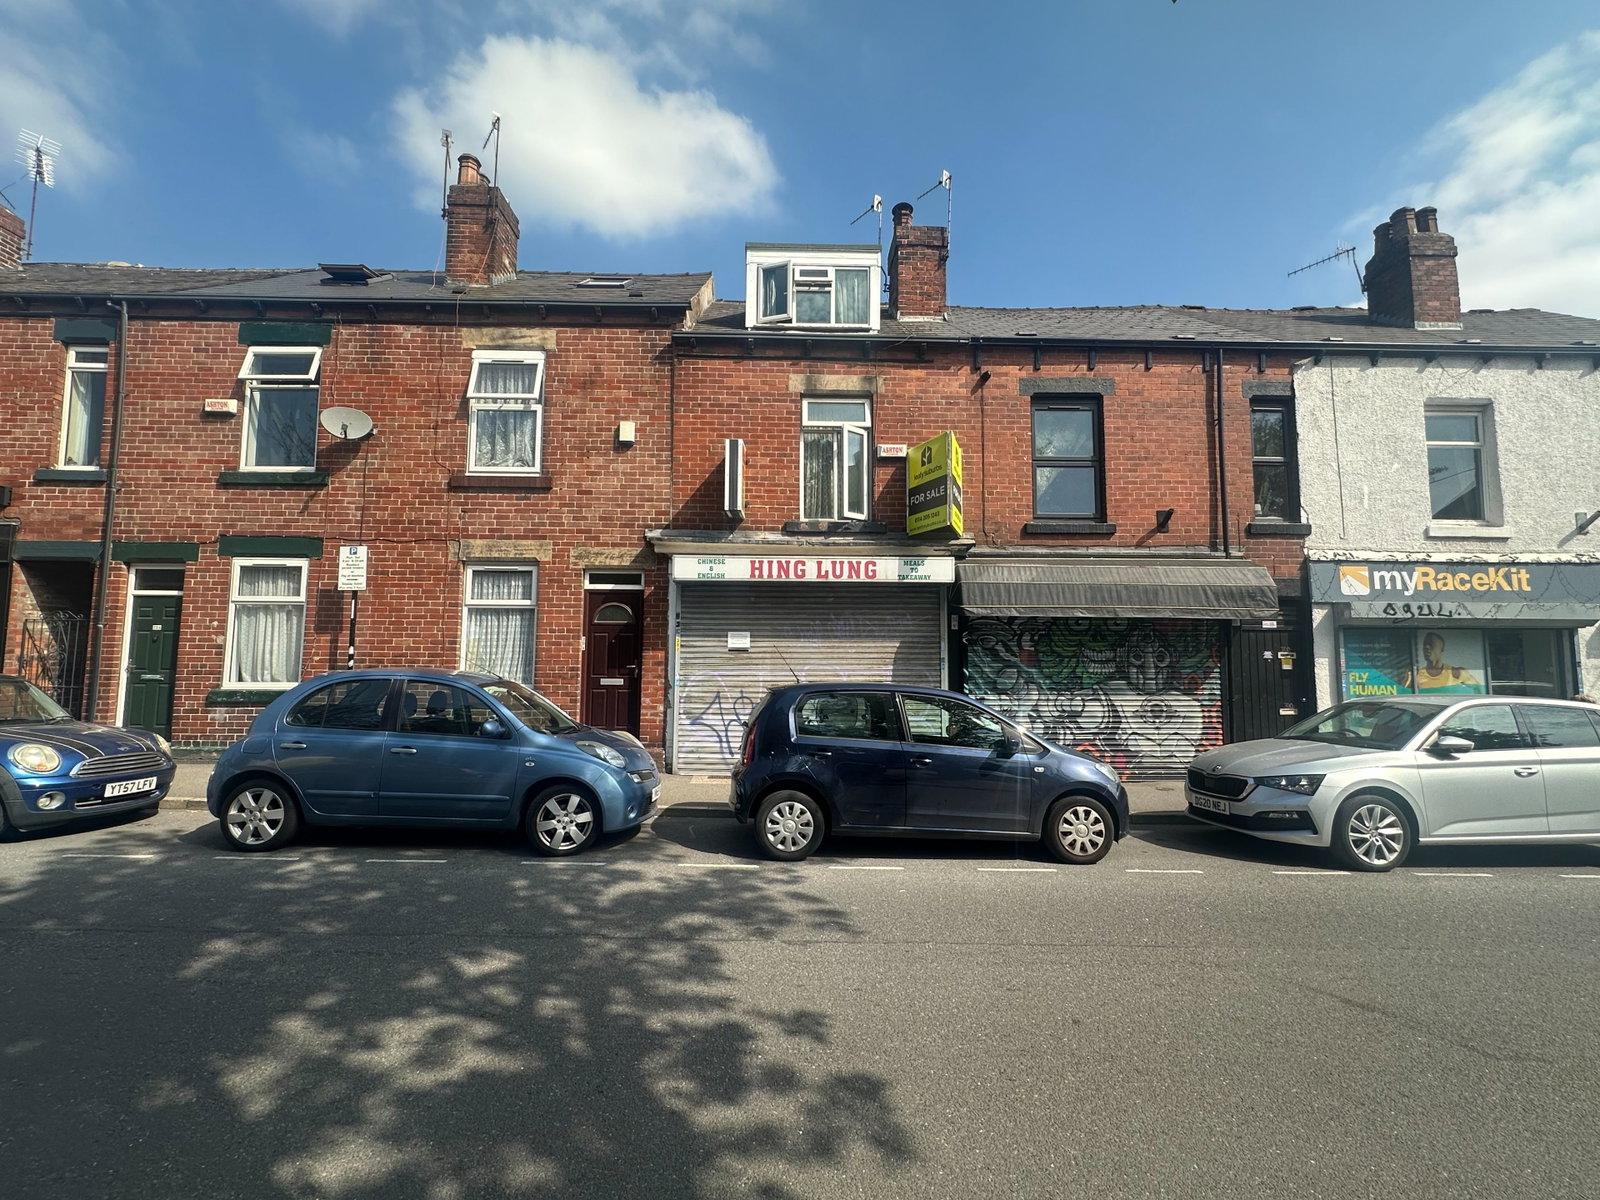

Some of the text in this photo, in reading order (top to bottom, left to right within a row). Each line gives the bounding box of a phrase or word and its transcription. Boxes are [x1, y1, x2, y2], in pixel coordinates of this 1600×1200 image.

[910, 493, 925, 506] FOR
[926, 485, 945, 501] SALE
[749, 559, 877, 579] HING LUNG
[1373, 566, 1531, 596] myRaceKit
[1349, 672, 1369, 683] FLY
[1350, 685, 1397, 696] HUMAN
[110, 779, 154, 795] YT57 LFV
[1211, 800, 1227, 813] NEJ
